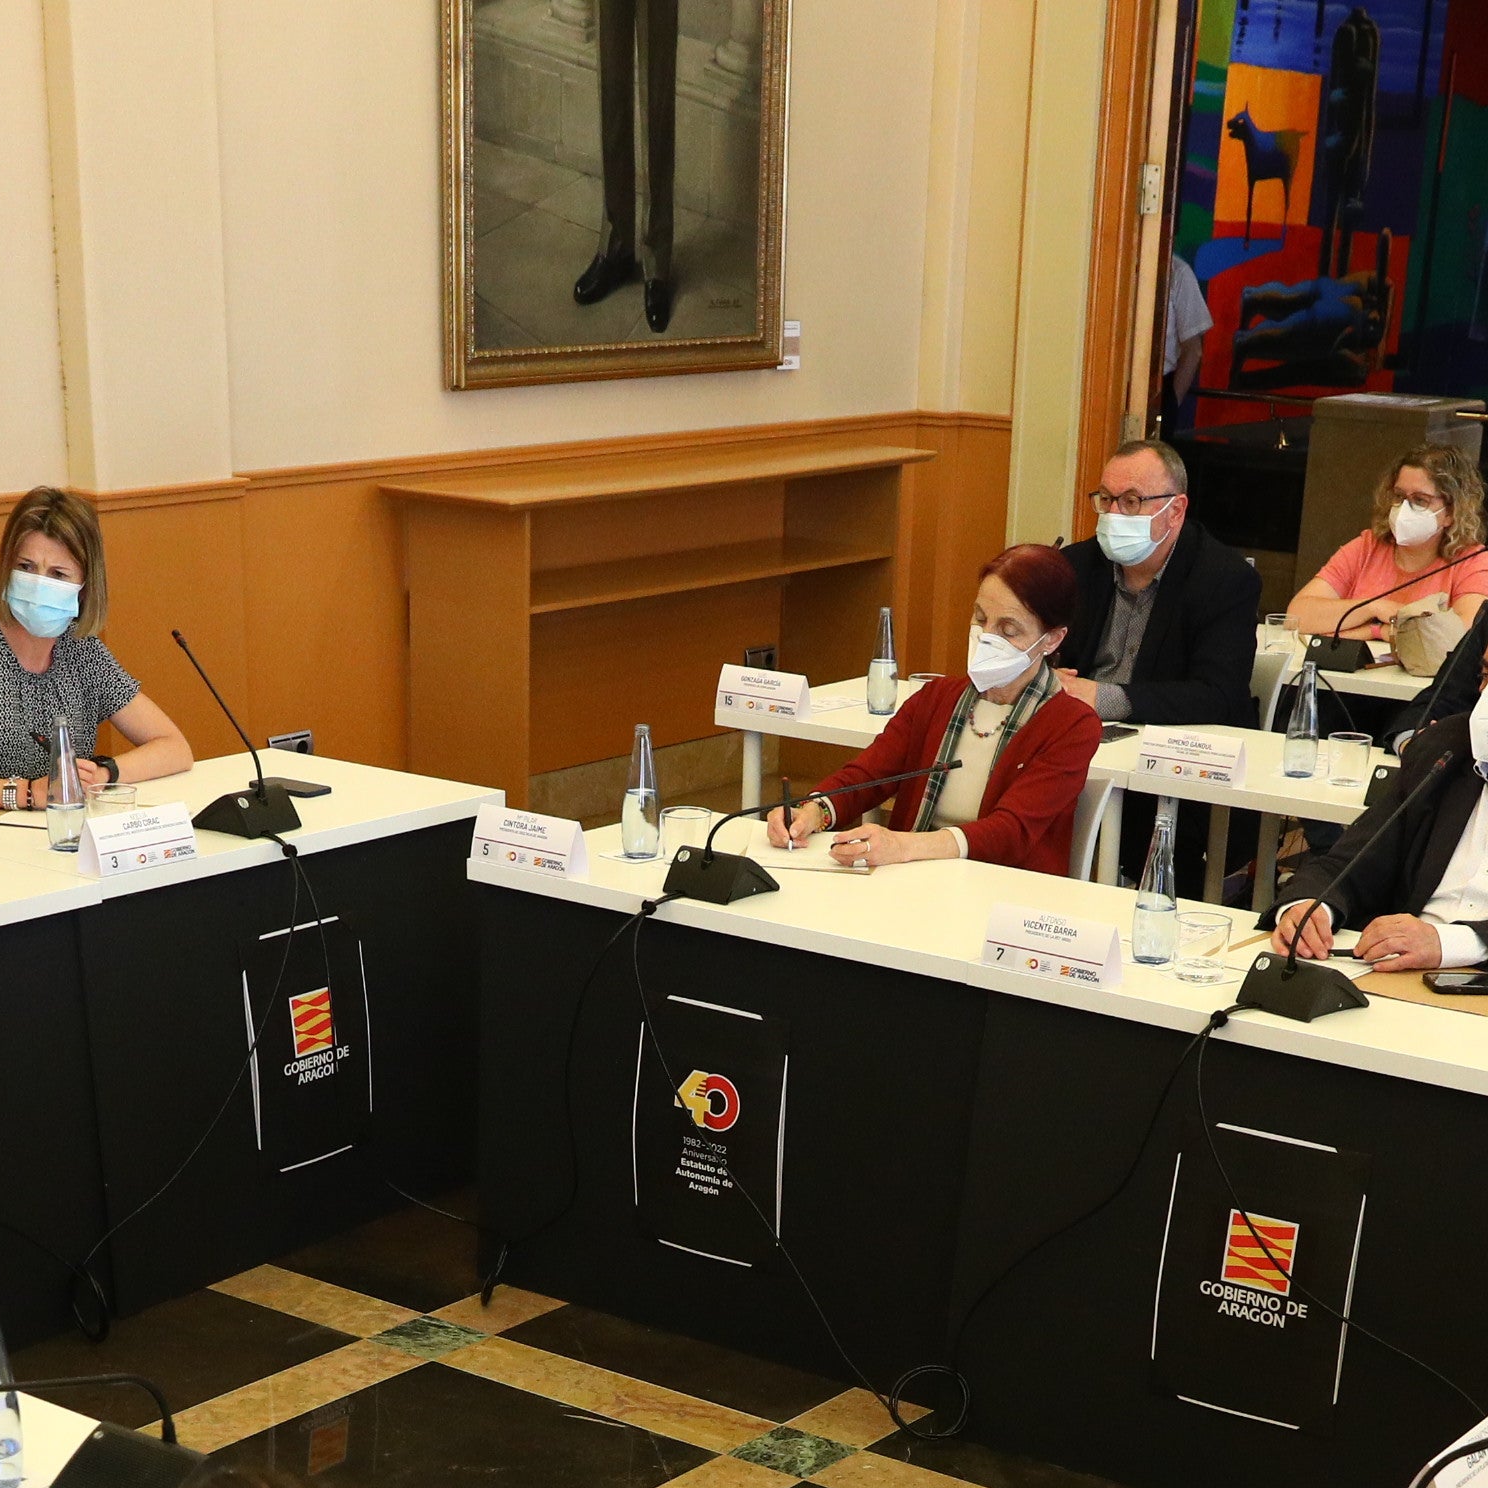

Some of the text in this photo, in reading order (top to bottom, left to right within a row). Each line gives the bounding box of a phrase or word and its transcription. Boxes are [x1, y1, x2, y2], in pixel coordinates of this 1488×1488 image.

[724, 696, 733, 706] 15
[1147, 759, 1157, 770] 17
[483, 844, 489, 855] 5
[112, 856, 118, 868] 3
[1023, 919, 1078, 938] VICENTE BARRA
[997, 947, 1005, 960] 7
[284, 1045, 350, 1076] GOBIERNO DE
[674, 1069, 740, 1132] 40
[682, 1147, 727, 1166] Aniversao
[680, 1157, 728, 1176] Estatuto de
[675, 1167, 733, 1189] Autonomía de
[689, 1181, 719, 1196] Aragón
[1199, 1280, 1308, 1319] GOBIERNO DE
[1217, 1300, 1286, 1329] ARAGON
